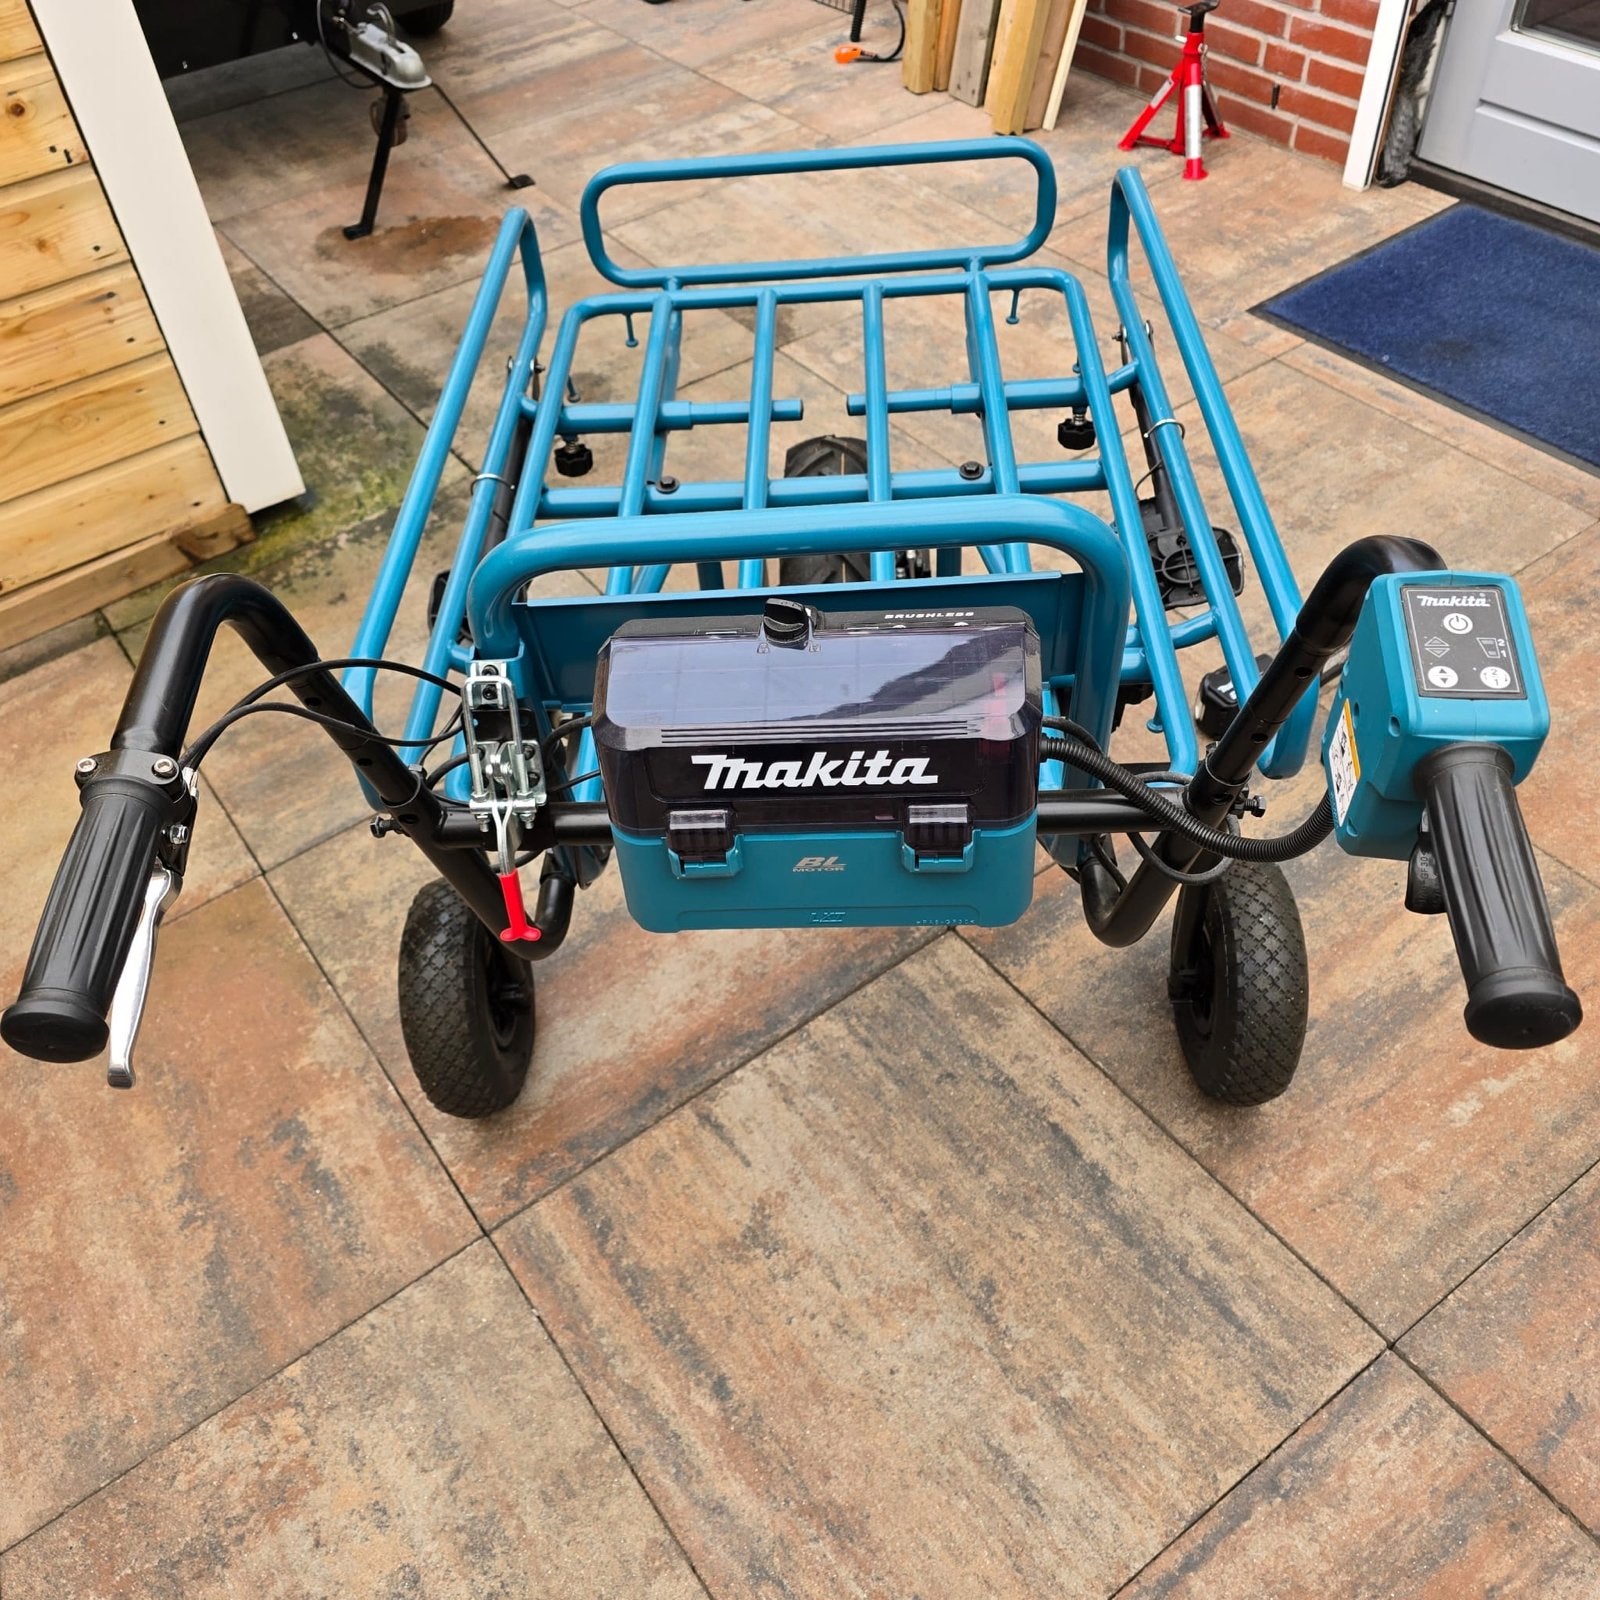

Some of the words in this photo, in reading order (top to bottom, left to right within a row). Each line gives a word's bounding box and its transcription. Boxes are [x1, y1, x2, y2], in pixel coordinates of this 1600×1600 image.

[884, 611, 975, 620] BRUSHLESS
[1497, 639, 1505, 647] 2
[1501, 650, 1507, 658] 1
[795, 856, 847, 867] BL
